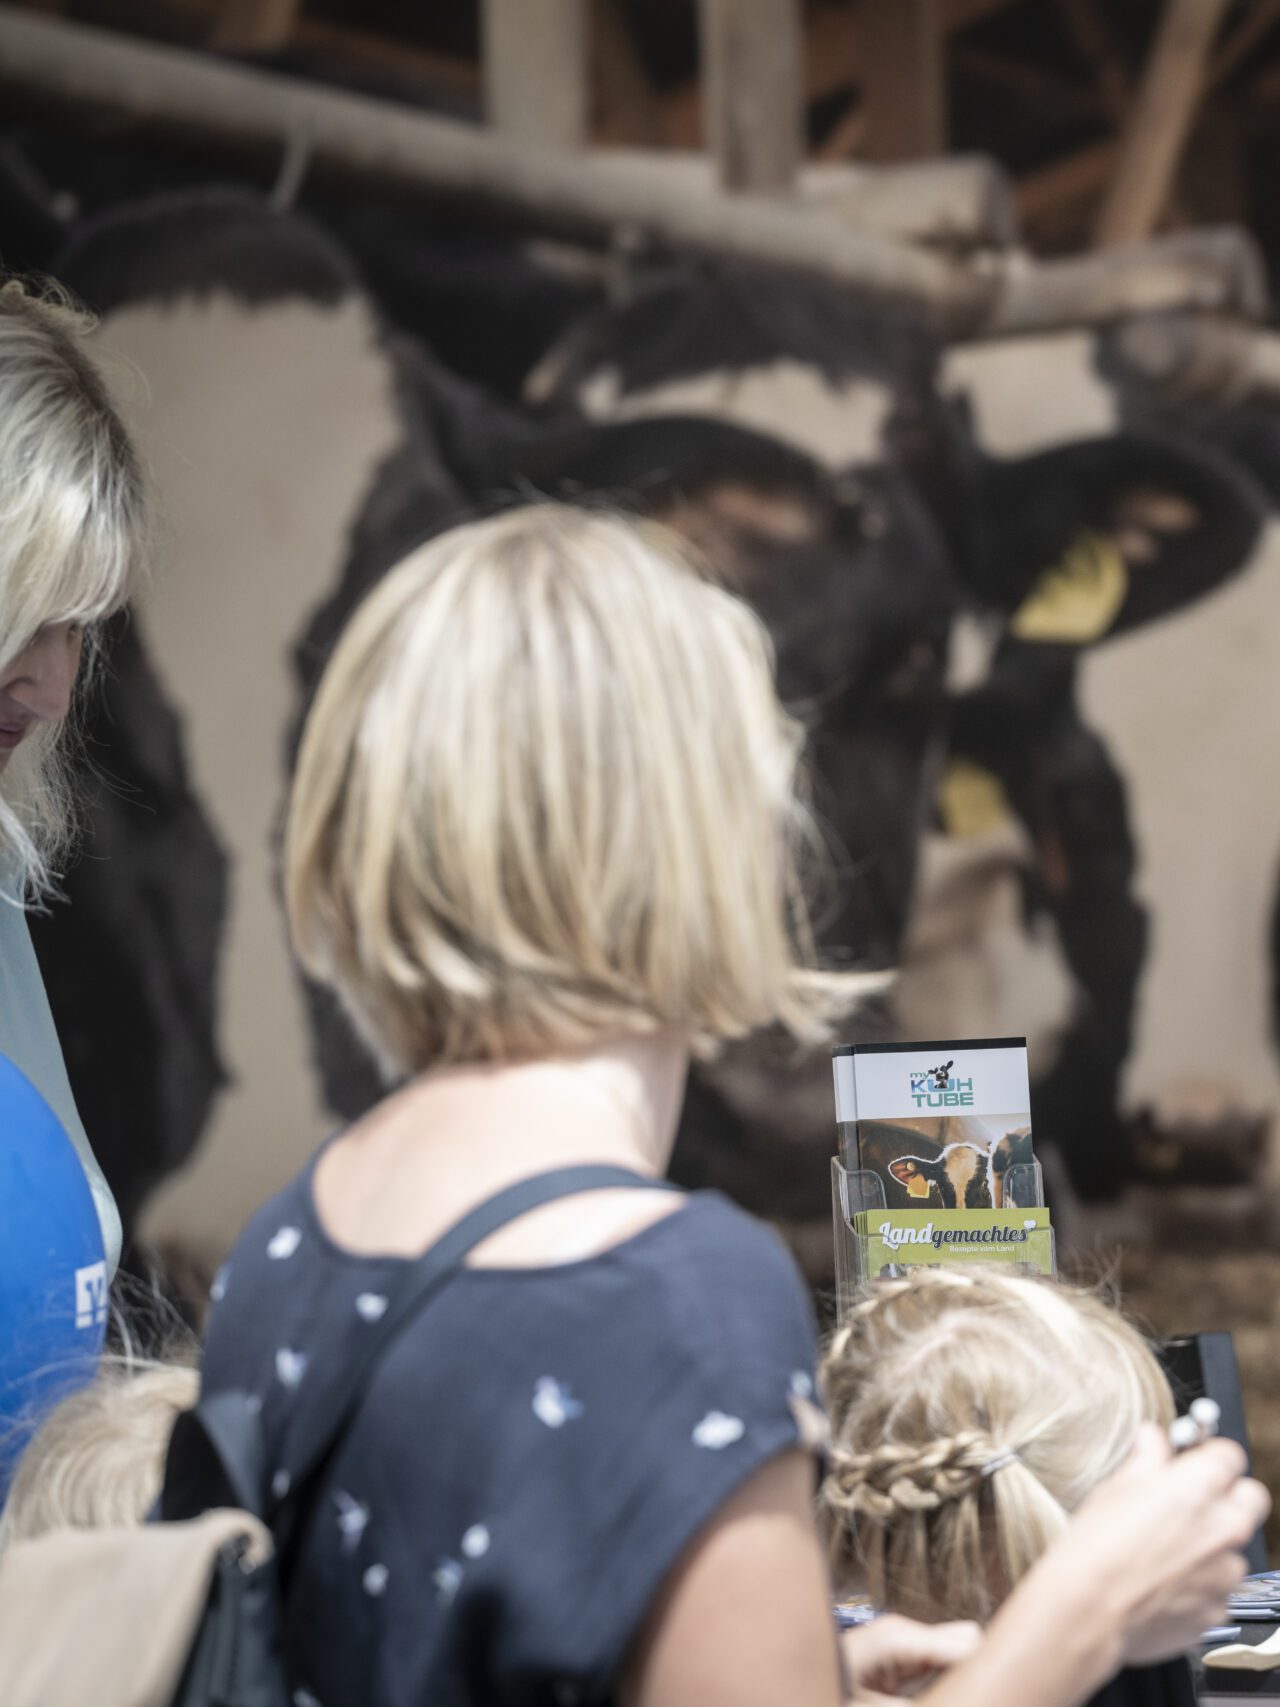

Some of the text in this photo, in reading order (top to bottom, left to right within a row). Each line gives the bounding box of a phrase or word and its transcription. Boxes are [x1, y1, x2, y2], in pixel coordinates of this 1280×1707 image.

[910, 1072, 930, 1080] my
[911, 1078, 973, 1093] KUH
[911, 1092, 974, 1108] TUBE
[879, 1222, 1028, 1250] Landgemachtes
